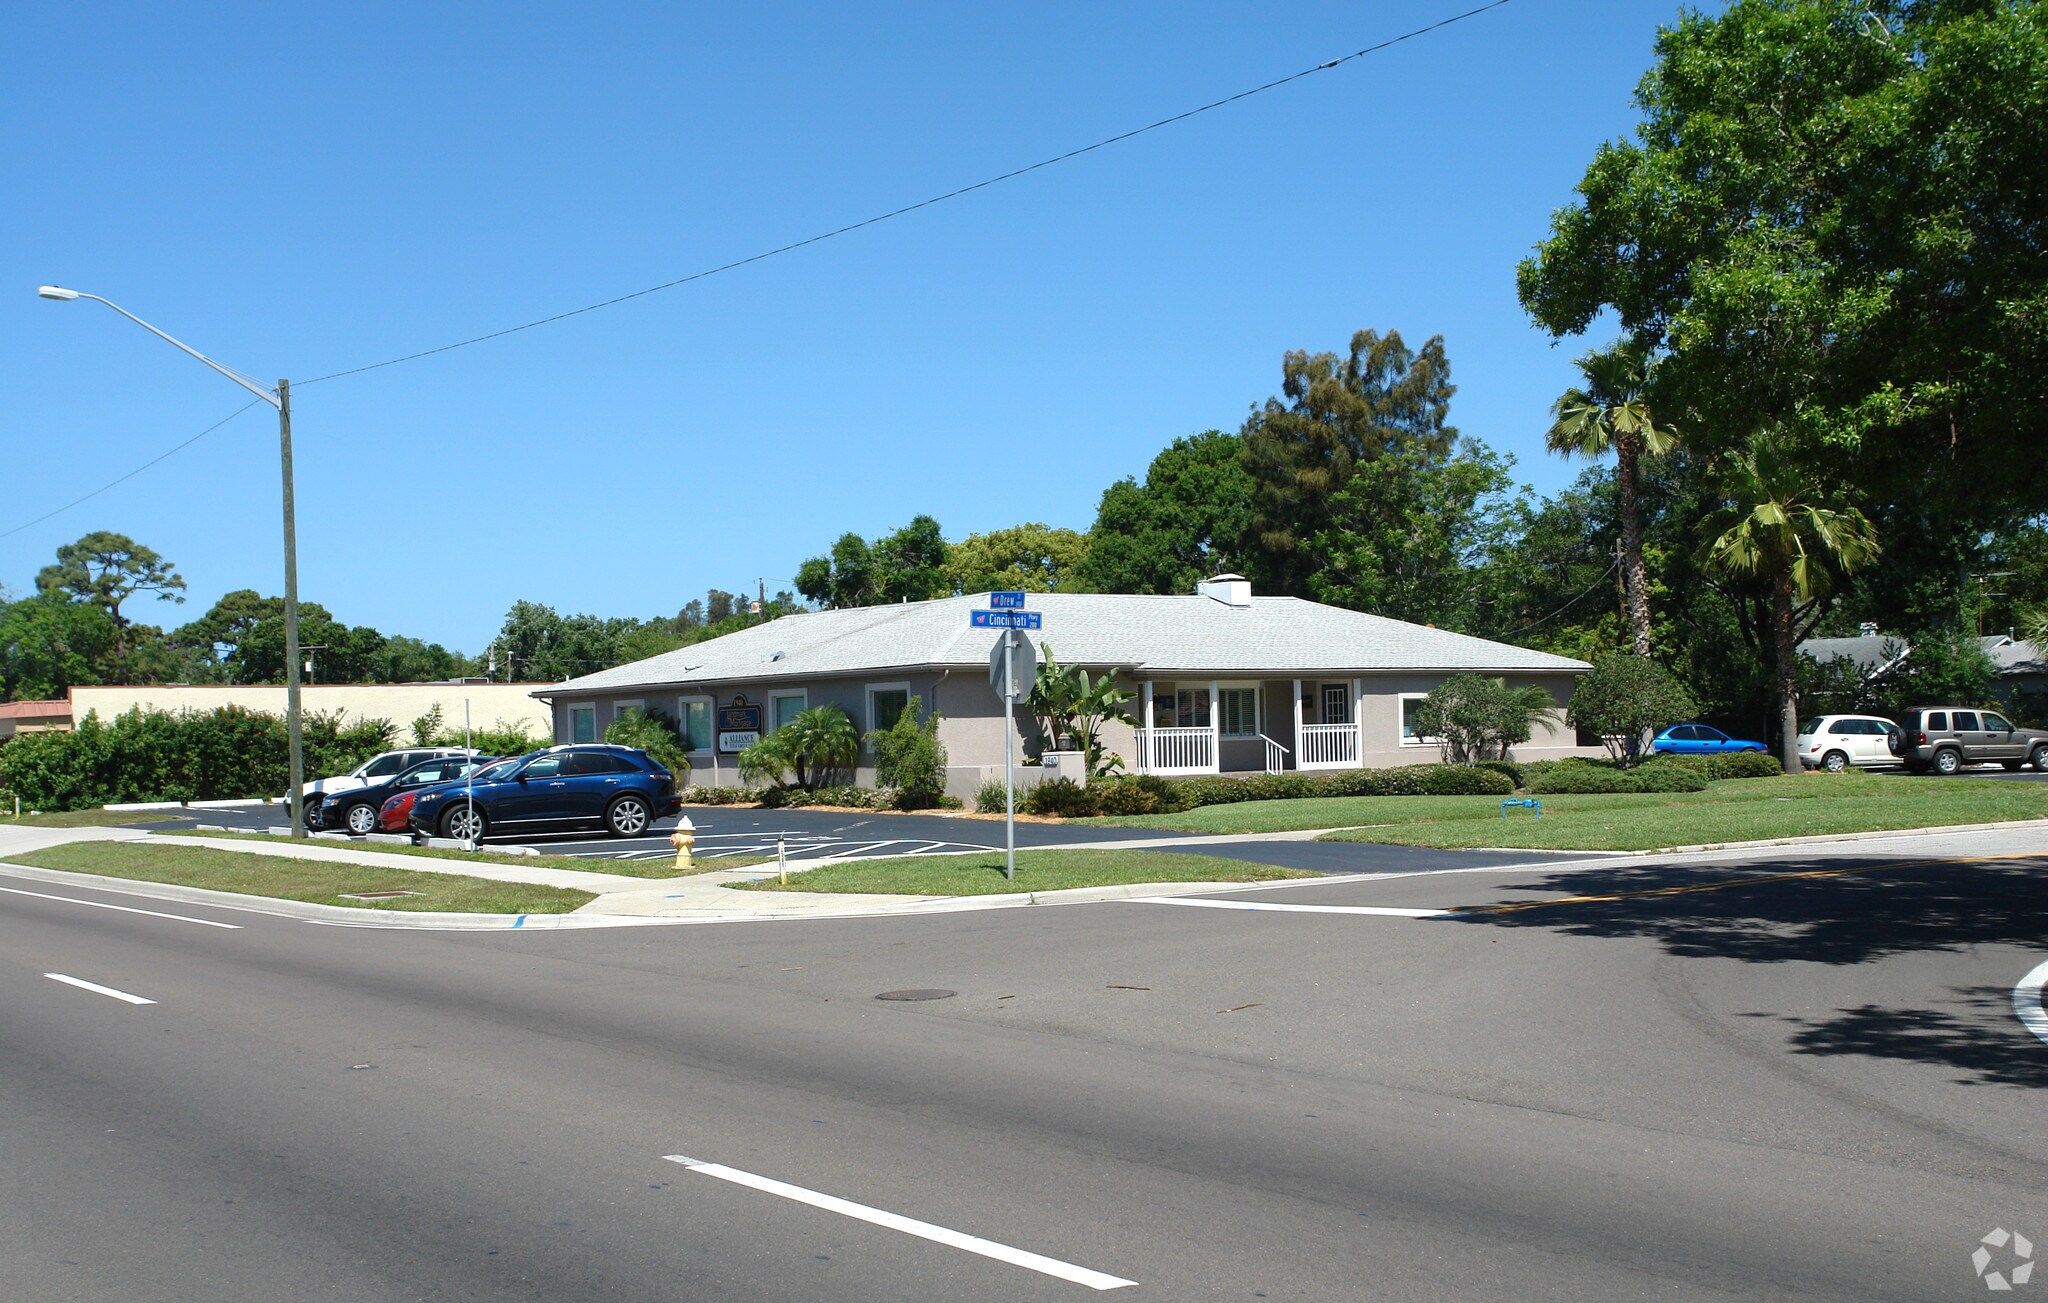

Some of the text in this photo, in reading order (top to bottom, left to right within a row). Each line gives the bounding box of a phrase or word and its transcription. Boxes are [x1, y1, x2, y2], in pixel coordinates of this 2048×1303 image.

[999, 594, 1015, 606] Drew
[989, 613, 1027, 627] Cincinnati
[729, 734, 754, 743] ALLIANCE
